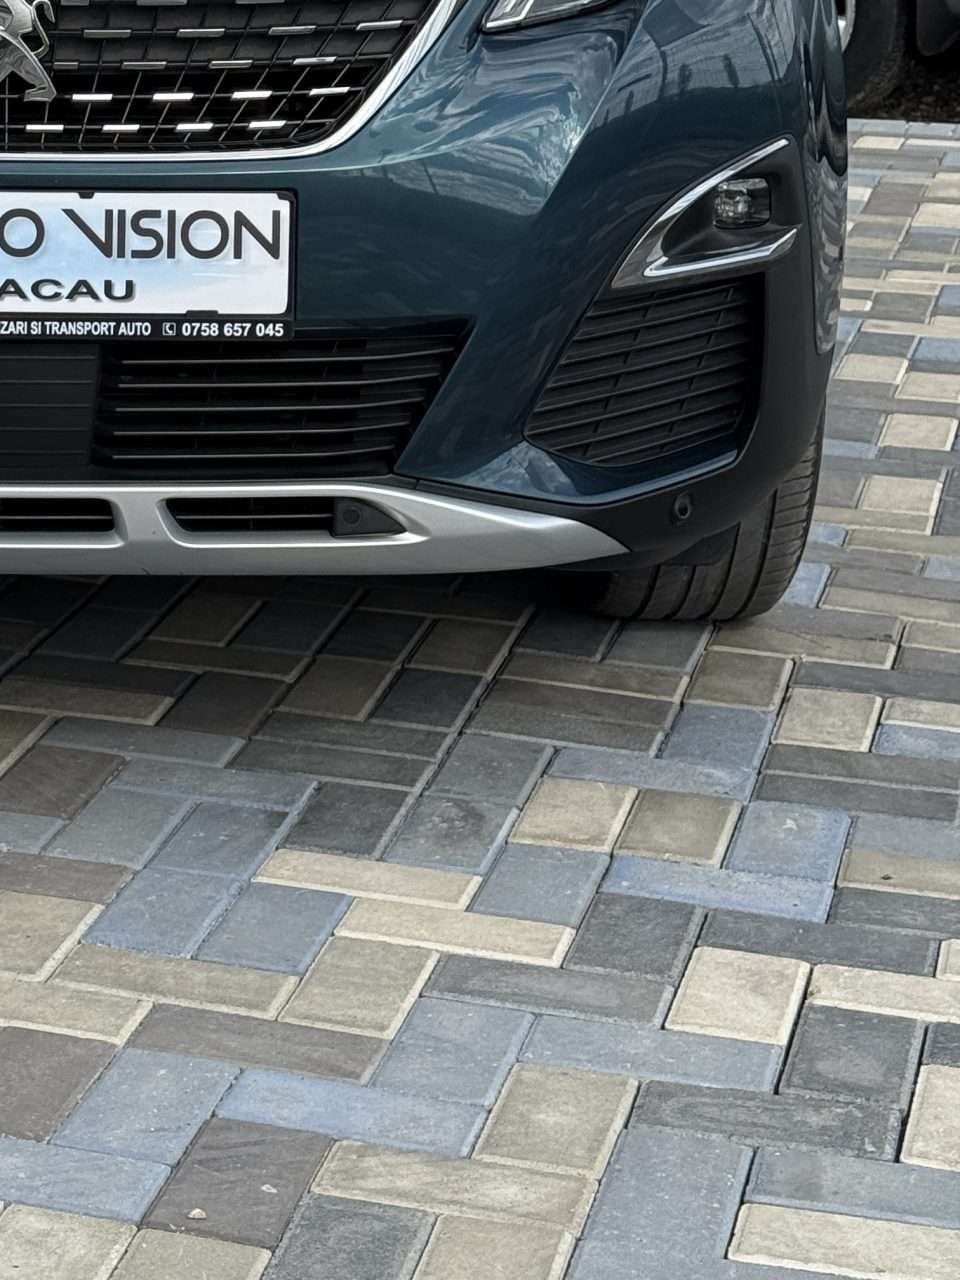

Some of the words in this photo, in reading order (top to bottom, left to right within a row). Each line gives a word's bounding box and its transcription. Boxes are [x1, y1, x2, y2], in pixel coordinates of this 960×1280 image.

[61, 208, 281, 261] VISION
[30, 320, 42, 335] SI
[45, 321, 117, 336] TRANSPORT
[118, 321, 152, 336] AUTO
[181, 321, 220, 337] 0758
[223, 322, 252, 337] 657
[255, 322, 285, 338] 045
